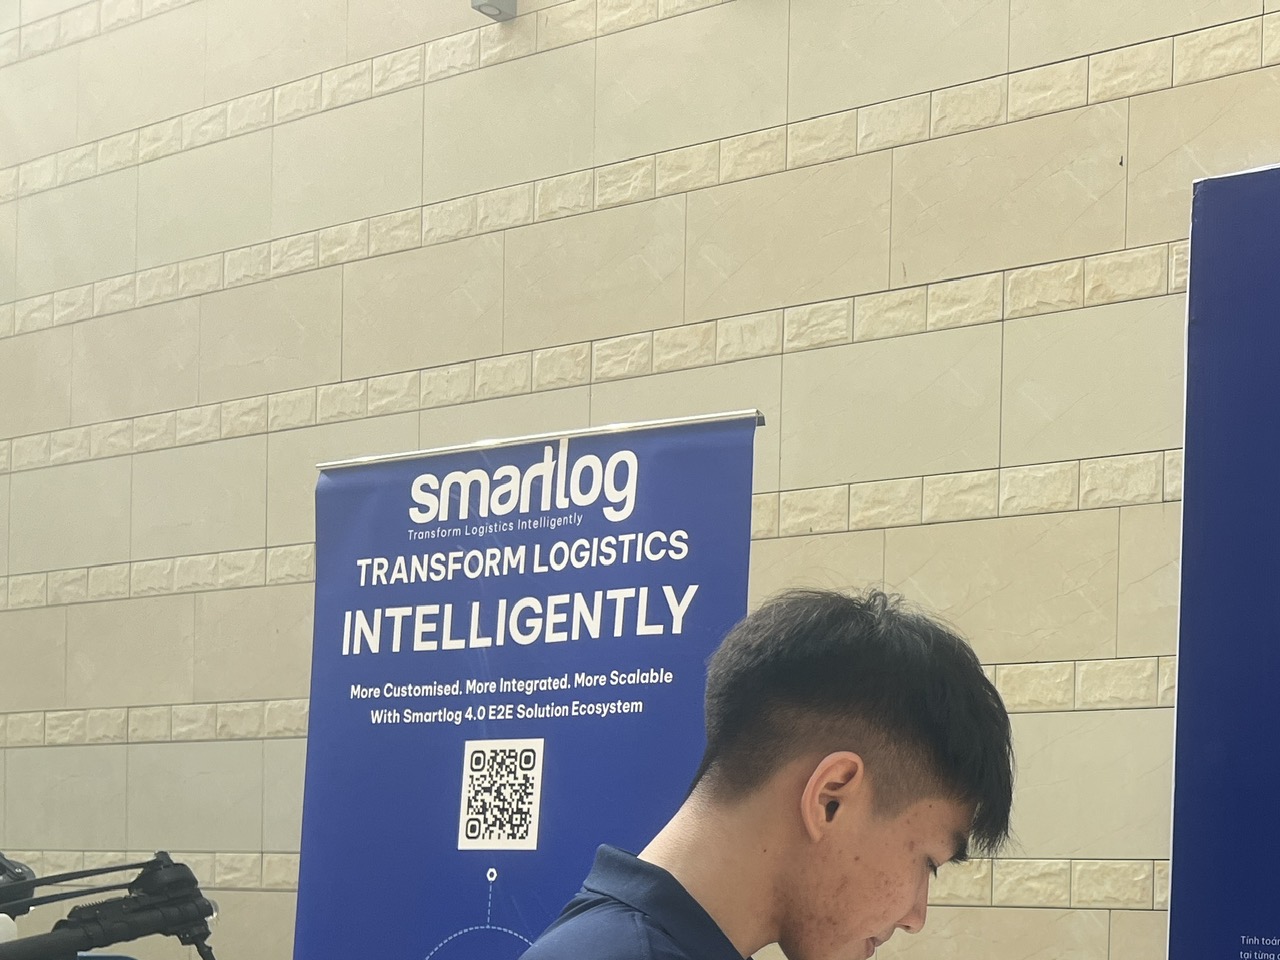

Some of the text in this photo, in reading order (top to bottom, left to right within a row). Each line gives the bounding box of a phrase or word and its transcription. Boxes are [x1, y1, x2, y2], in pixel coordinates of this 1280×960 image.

[411, 438, 638, 523] smartlog
[408, 512, 583, 540] Transform Logistics Intelligently
[357, 530, 688, 586] TRANSFORM LOGISTICS
[342, 585, 699, 655] INTELLIGENTLY
[350, 668, 673, 699] More Customised. More Integrated. More Scalable
[371, 700, 643, 725] With Smartlog 4.0 E2E Solution Ecosystem
[1241, 936, 1259, 945] Tính
